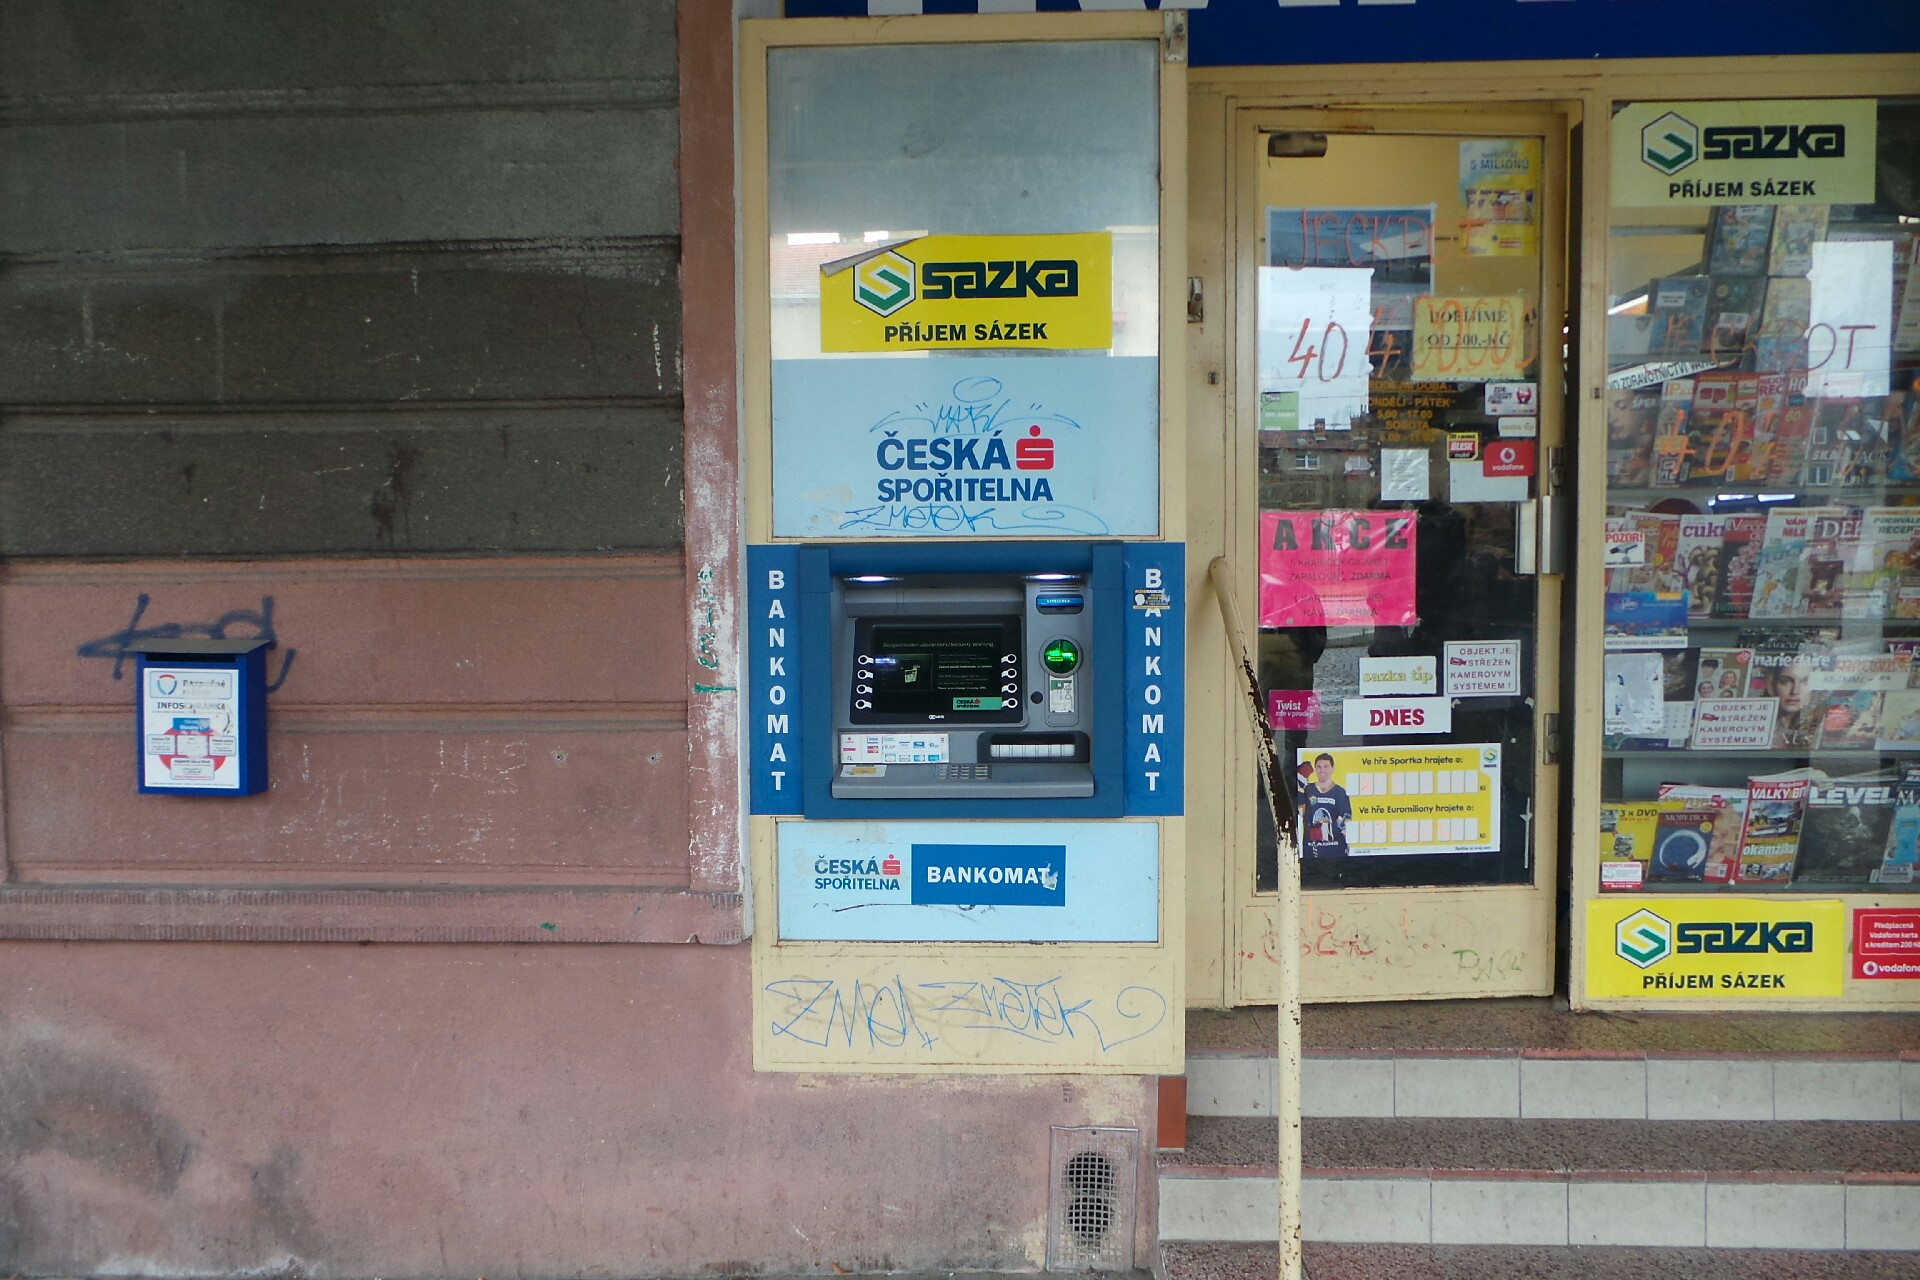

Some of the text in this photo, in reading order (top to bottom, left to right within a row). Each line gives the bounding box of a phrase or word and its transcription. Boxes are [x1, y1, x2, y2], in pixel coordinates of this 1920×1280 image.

[1669, 177, 1816, 198] PŘÍJEM SÁZEK
[885, 319, 1048, 342] PŘÍJEM SÁZEK
[876, 430, 1011, 470] ČESKÁ
[1451, 442, 1474, 451] BLESK
[1492, 463, 1525, 471] vodafone
[877, 473, 1053, 502] SPOŘITELNA
[1605, 532, 1643, 544] POZOR!
[1350, 571, 1392, 580] ZDARMA
[1500, 647, 1512, 655] JE
[1468, 657, 1511, 666] STŘEŽEN
[1753, 652, 1791, 667] marie
[1793, 653, 1830, 668] claire
[767, 570, 788, 790] BANKOMAT
[1363, 665, 1433, 684] sazka tip
[1276, 699, 1301, 710] Twist
[1713, 703, 1769, 712] OBJEKT JE
[1369, 708, 1425, 726] DNES
[1720, 713, 1767, 722] STŘEŽEN
[1361, 757, 1372, 765] Ve
[1374, 756, 1387, 765] hře
[1389, 756, 1422, 766] Sportka
[1424, 756, 1453, 766] hrajete
[1809, 786, 1896, 805] LEVEL
[1359, 806, 1369, 814] Ve
[1371, 804, 1384, 814] hře
[1387, 804, 1433, 815] Euromiliony
[1435, 803, 1464, 814] hrajete
[1619, 809, 1627, 818] 3
[1636, 808, 1658, 818] DVD
[1664, 813, 1709, 822] MOBY DICK
[814, 855, 879, 875] ČESKÁ
[927, 865, 1049, 885] BANKOMAT
[814, 876, 901, 891] SPOŘITELNA
[1873, 921, 1914, 930] Předplacená
[1901, 931, 1918, 939] karta
[1643, 971, 1786, 989] PŘÍJEM SÁZEK
